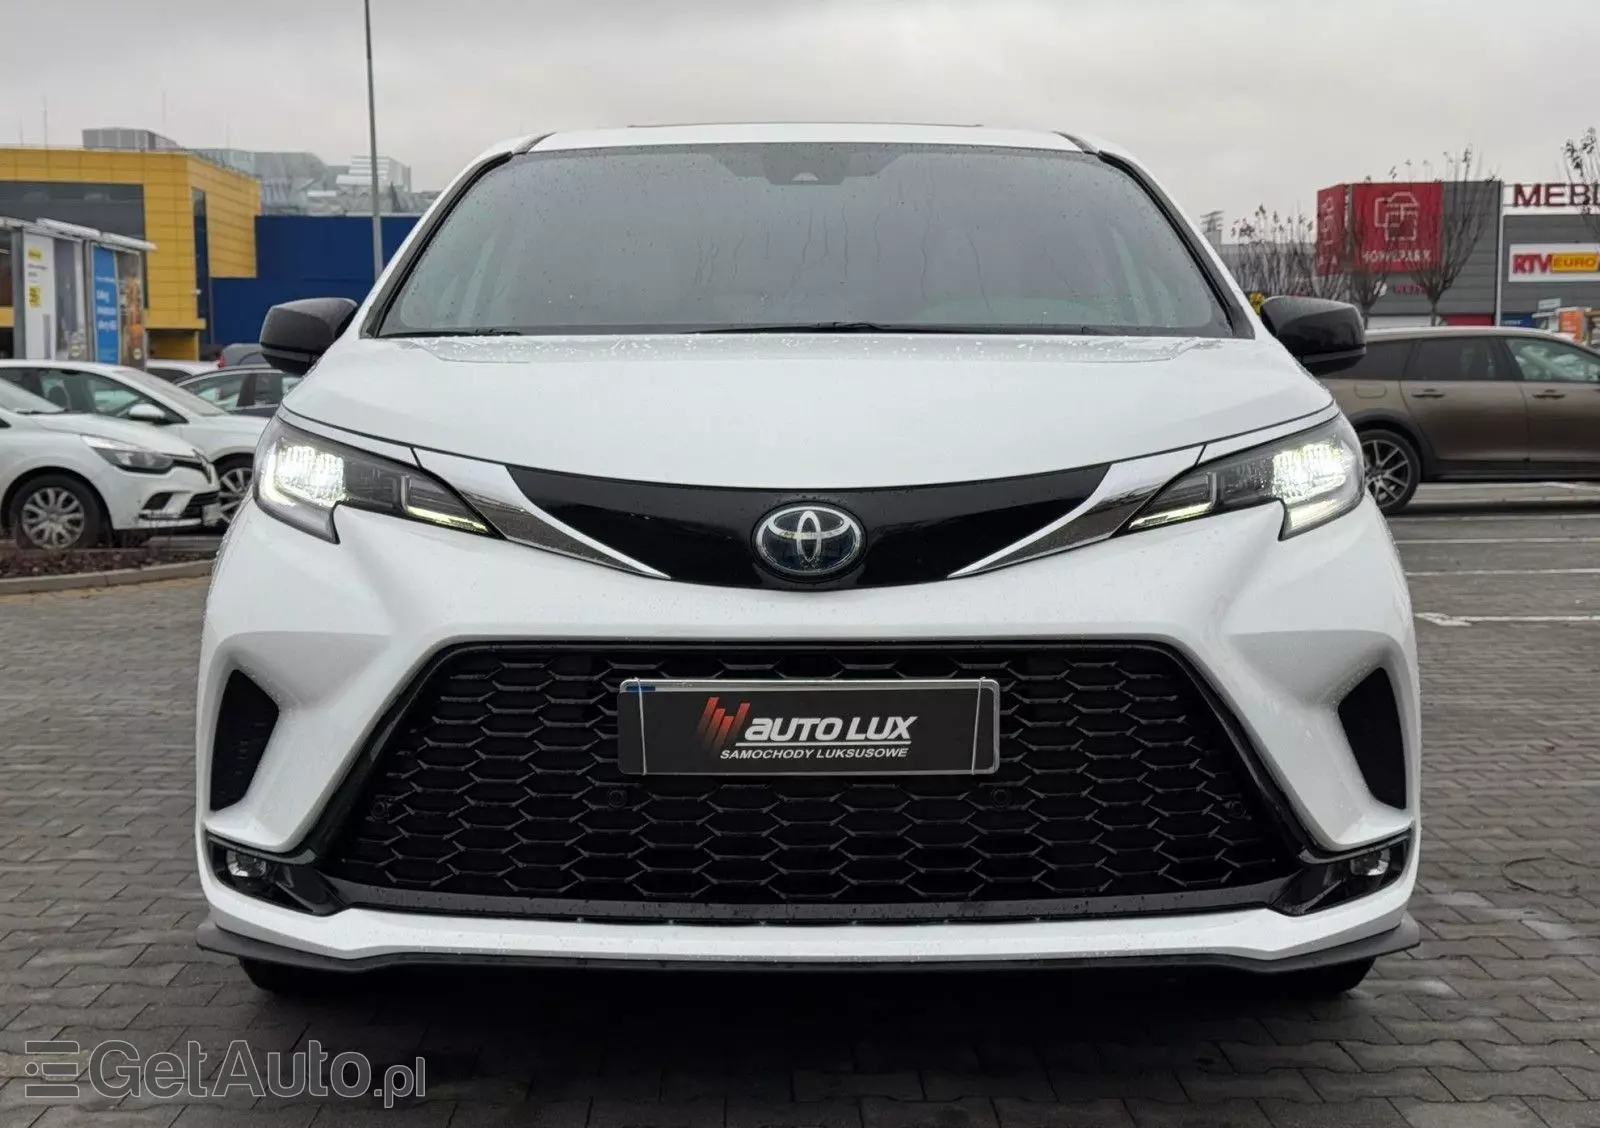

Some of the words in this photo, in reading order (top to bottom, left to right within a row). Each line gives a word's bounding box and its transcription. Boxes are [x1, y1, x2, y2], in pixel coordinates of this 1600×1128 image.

[1513, 253, 1552, 274] RTV
[1553, 255, 1597, 268] EURO
[846, 716, 918, 741] LUX
[720, 749, 814, 760] SAMOCHODY
[816, 748, 908, 759] LUKSUSOWE
